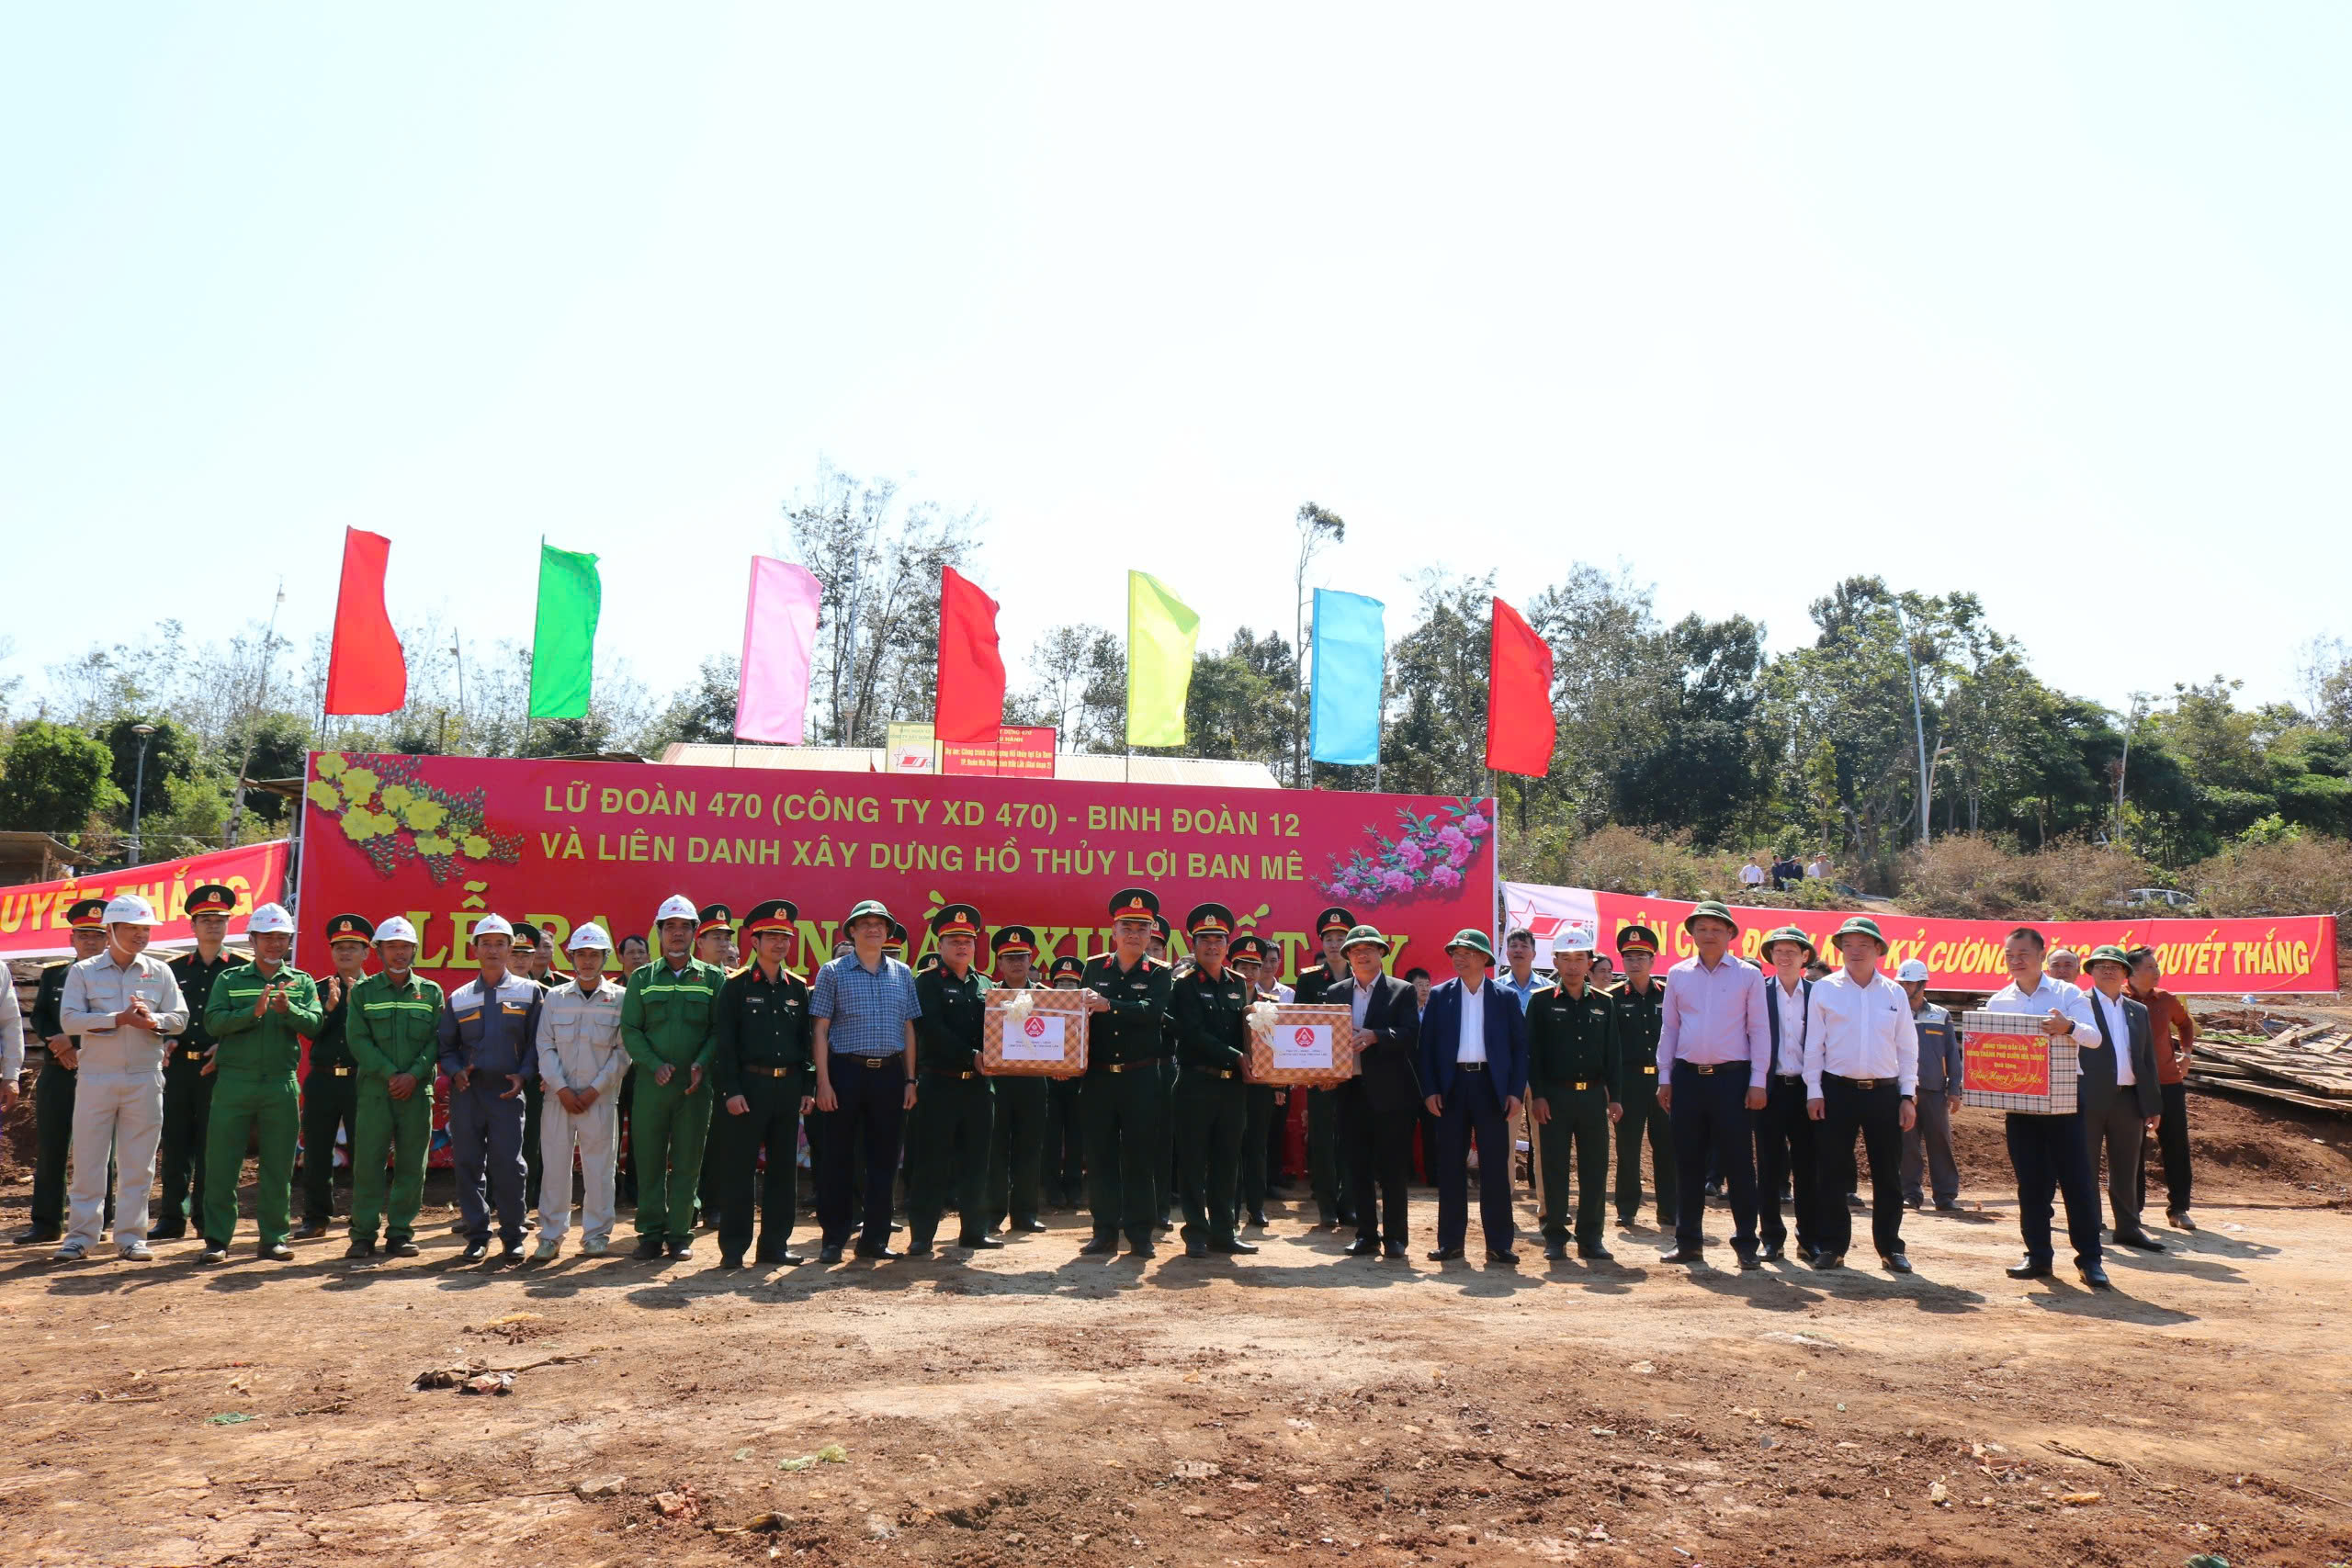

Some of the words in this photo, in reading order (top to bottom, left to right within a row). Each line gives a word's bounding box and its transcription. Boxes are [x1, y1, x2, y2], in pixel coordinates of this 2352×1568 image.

[544, 780, 591, 813] LỮ
[601, 783, 696, 817] ĐOÀN
[707, 793, 762, 818] 470
[773, 788, 879, 826] (CÔNG
[891, 798, 931, 824] TY
[942, 800, 985, 826] XD
[995, 803, 1057, 834] 470)
[1088, 806, 1161, 832] BINH
[1172, 804, 1258, 836] ĐOÀN
[1270, 813, 1300, 837] 12
[540, 826, 585, 860] VÀ
[598, 828, 675, 863] LIÊN
[687, 837, 780, 865] DANH
[791, 834, 858, 868] XÂY
[870, 840, 963, 875] DỰNG
[975, 836, 1021, 874] HỒ
[1031, 840, 1116, 875] THỦY
[1127, 849, 1177, 882] LỢI
[1188, 853, 1250, 879] BAN
[1261, 850, 1304, 881] MÊ
[2154, 929, 2227, 976] QUYẾT
[2232, 927, 2310, 975] THẮNG
